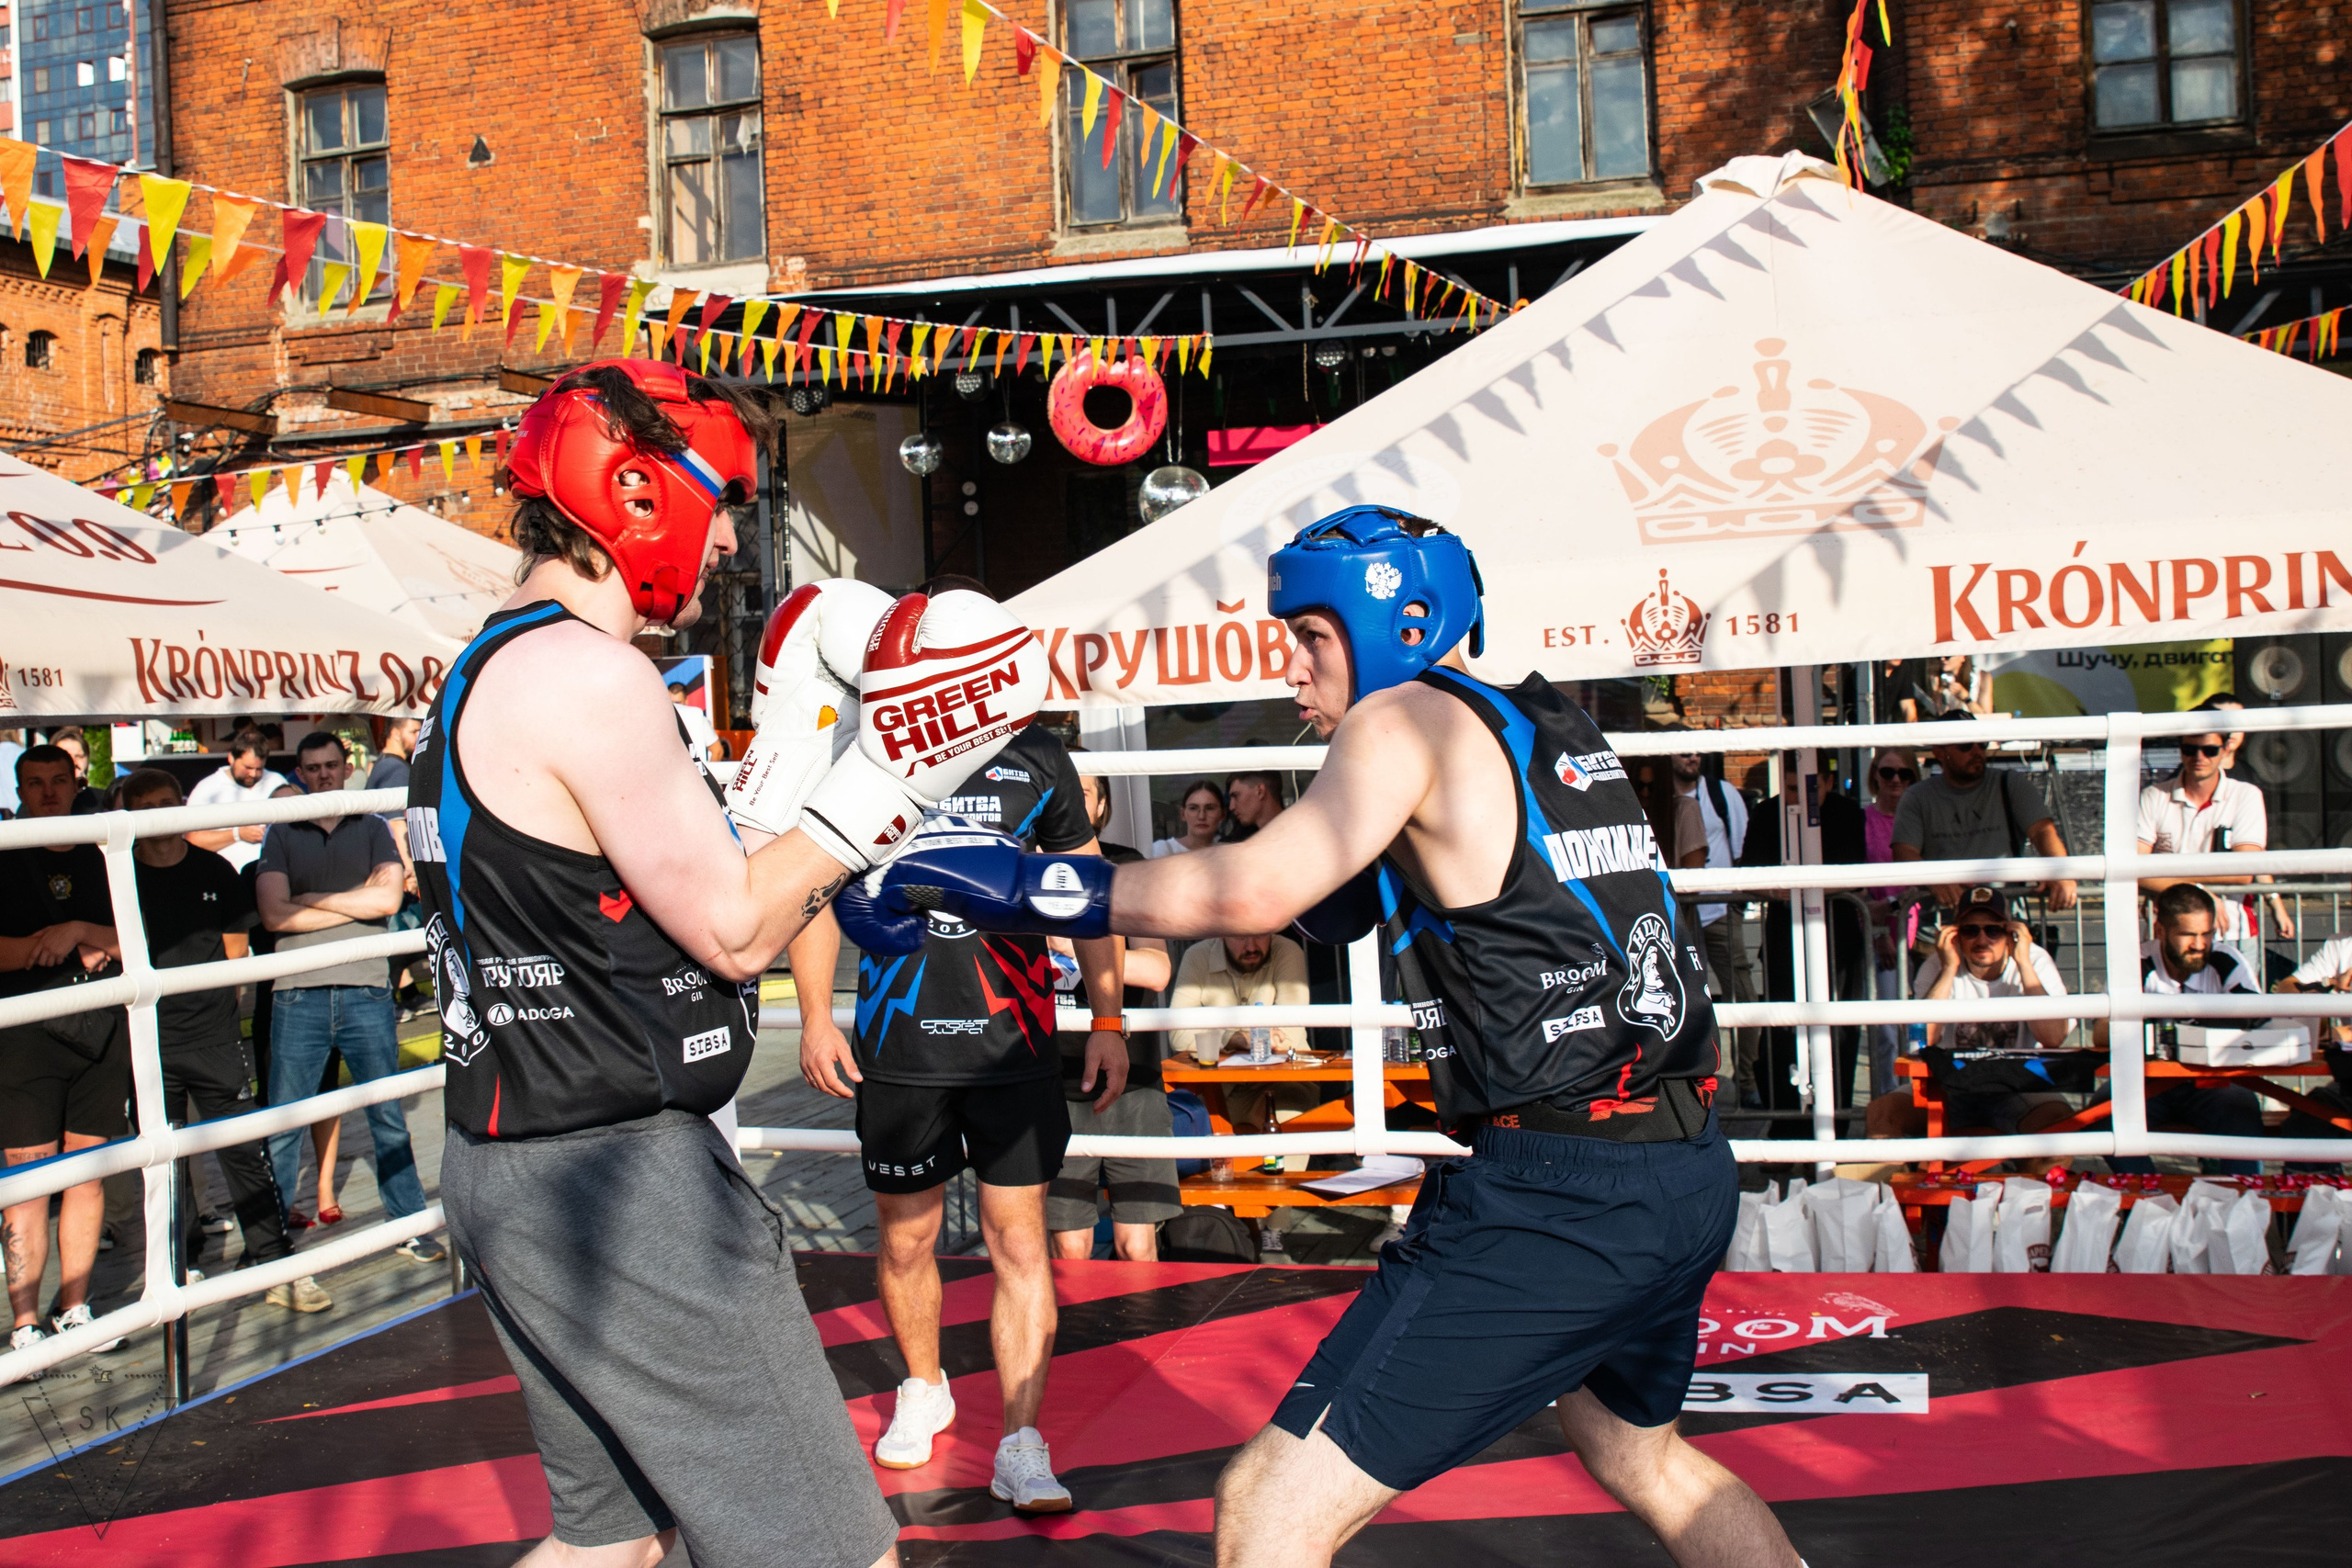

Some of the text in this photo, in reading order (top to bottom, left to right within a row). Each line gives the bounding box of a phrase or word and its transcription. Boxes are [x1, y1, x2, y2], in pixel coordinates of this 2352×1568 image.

[1725, 612, 1798, 636] 1581
[1544, 626, 1610, 648] EST.
[2057, 650, 2138, 671] Шучу,
[17, 667, 63, 687] 1581
[873, 660, 1020, 732] GREEN
[881, 700, 1008, 762] HILL
[934, 750, 947, 763] BE
[947, 739, 973, 758] YOUR
[972, 730, 995, 749] BEST
[736, 758, 758, 792] HILL
[1539, 960, 1608, 990] BROOM
[1566, 984, 1584, 995] GIN
[518, 1006, 576, 1021] ADOGA
[689, 1032, 728, 1056] SIBSA
